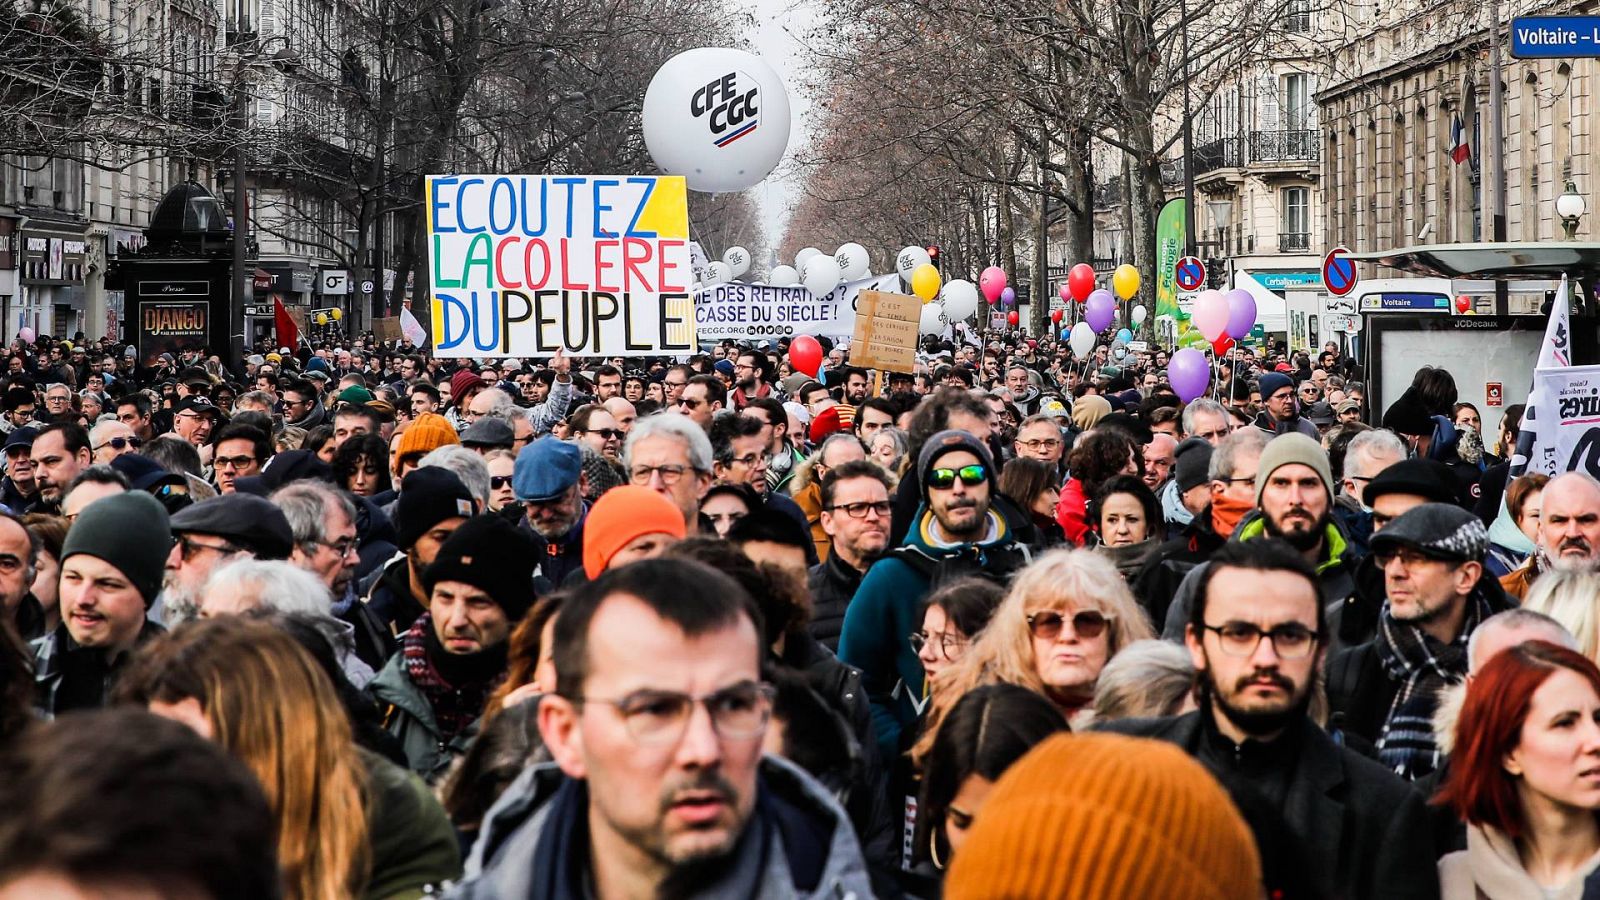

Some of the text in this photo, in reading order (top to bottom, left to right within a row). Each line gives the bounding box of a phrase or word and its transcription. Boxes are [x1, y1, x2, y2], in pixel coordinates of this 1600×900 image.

[1518, 27, 1577, 45] Voltaire
[691, 72, 736, 117] CFE
[709, 88, 758, 134] CGC
[432, 174, 657, 238] ÉCOUTEZ
[433, 228, 685, 293] LA COLÈRE
[716, 286, 745, 302] DES
[751, 286, 834, 302] RETRAIS
[839, 286, 847, 300] ?
[145, 309, 204, 335] DJANGO
[435, 289, 690, 354] DU PEUPLE
[696, 306, 747, 323] CASSE
[752, 306, 771, 322] DU
[777, 302, 829, 321] SIÈCLE
[1455, 320, 1498, 328] JCDecaux
